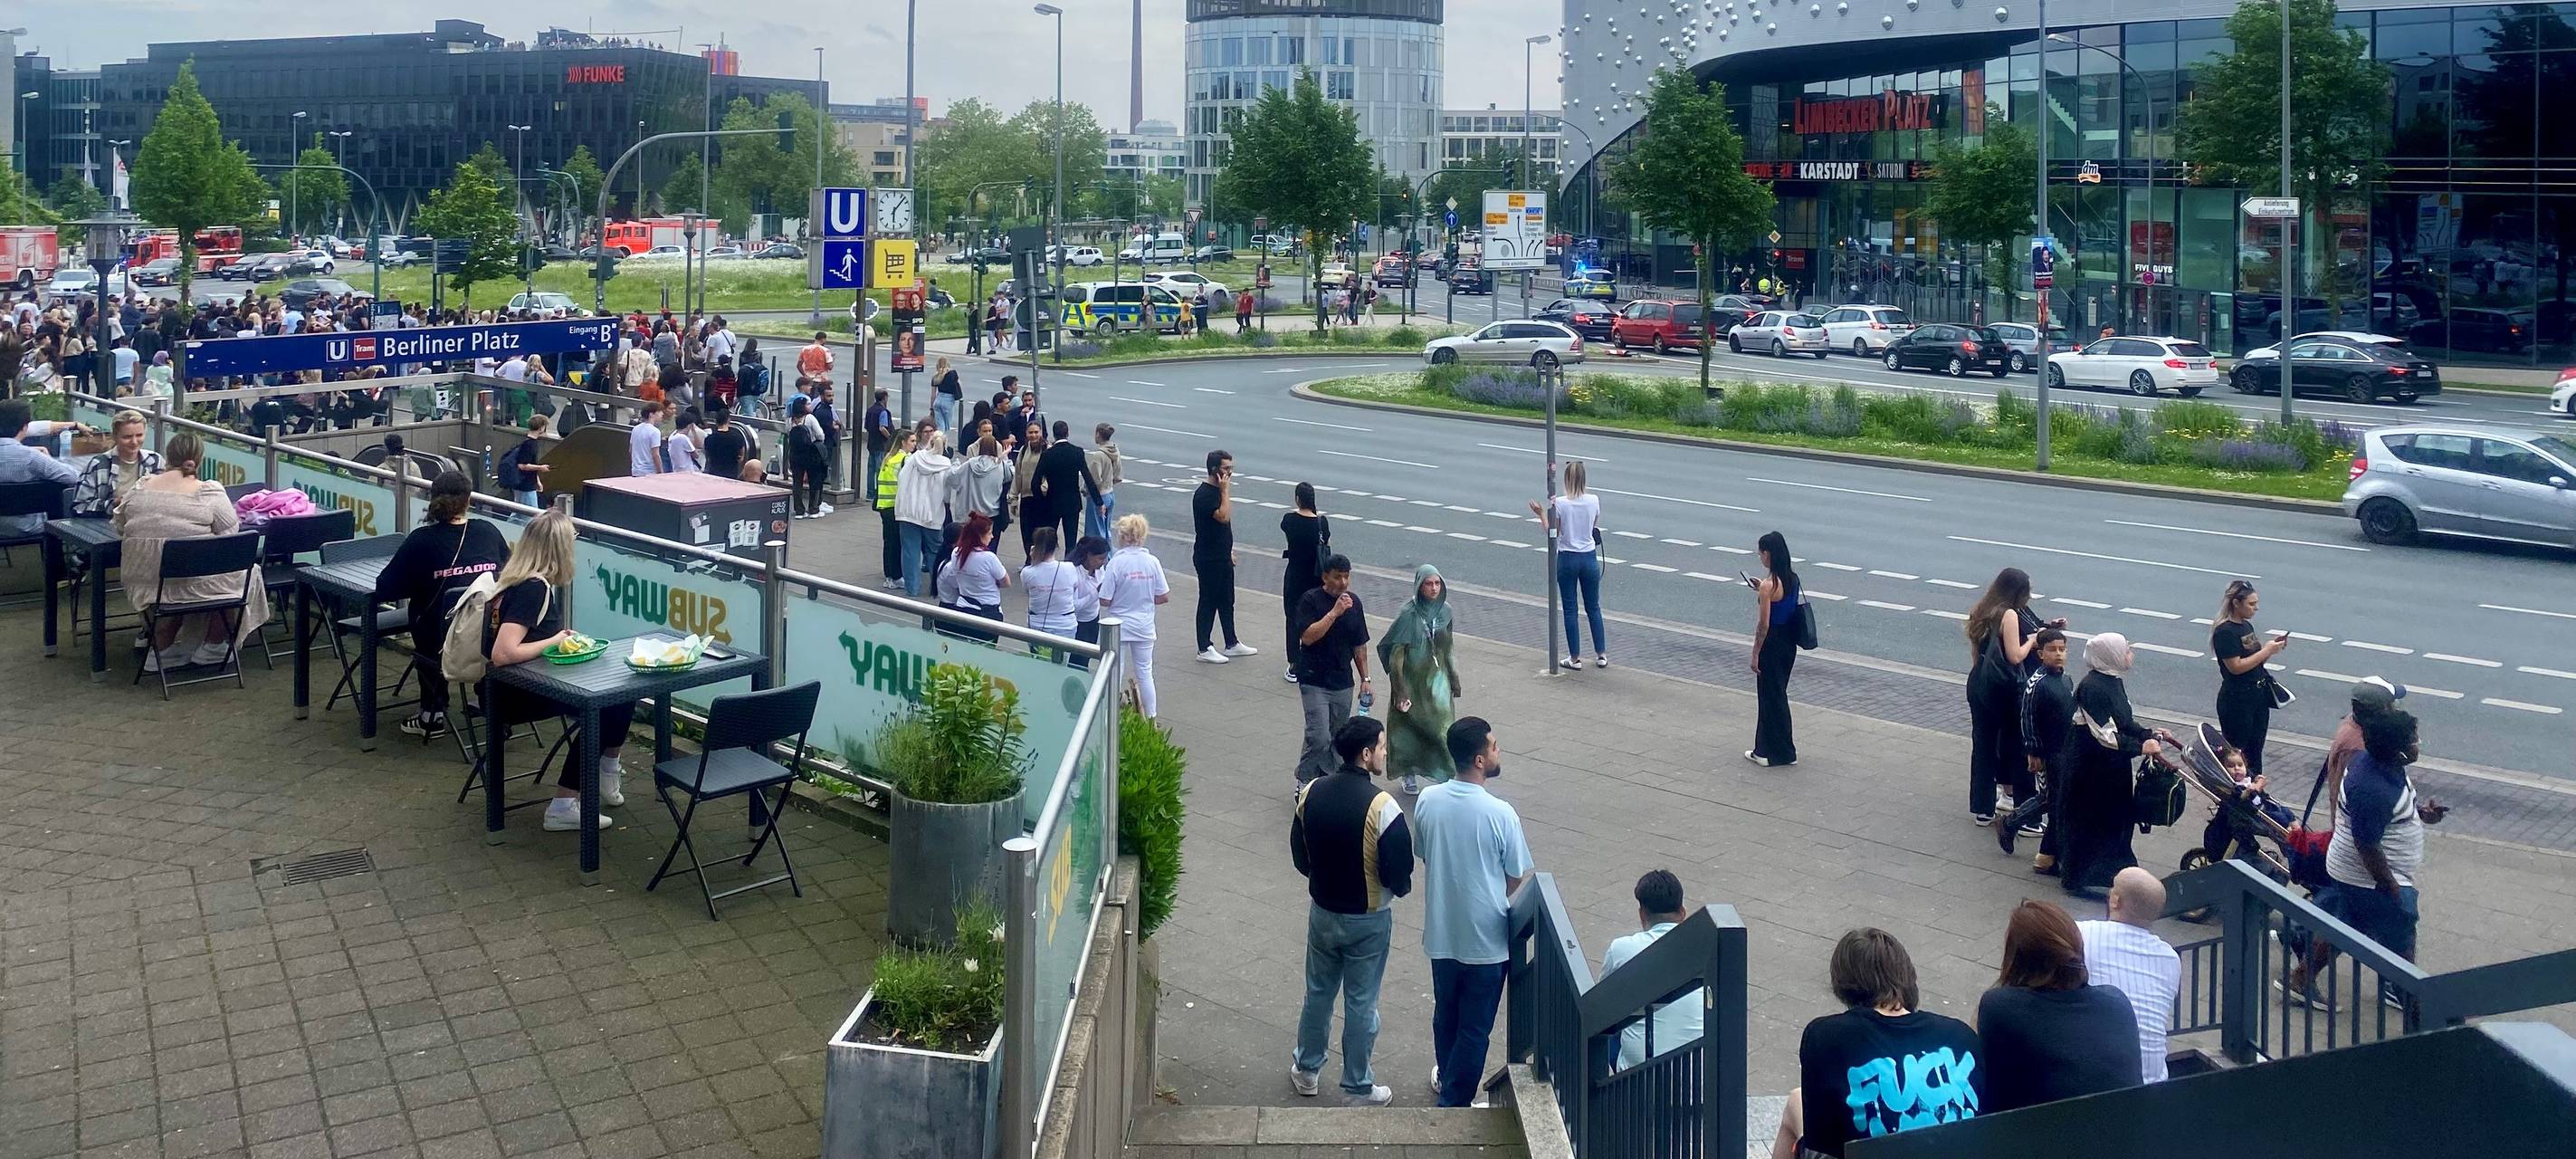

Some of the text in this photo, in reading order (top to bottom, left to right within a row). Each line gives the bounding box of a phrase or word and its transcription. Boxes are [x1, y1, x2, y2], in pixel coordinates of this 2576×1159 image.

[584, 65, 624, 82] FUNKE
[1795, 89, 1932, 134] LIMBECKER PLATZ
[1800, 162, 1859, 180] KARSTADT
[1877, 163, 1903, 179] SATURN
[831, 193, 859, 233] U
[2153, 264, 2173, 273] GUYS
[569, 324, 611, 343] Eingang B
[329, 330, 520, 360] U Tram Berliner Platz
[434, 562, 497, 580] PEGADOR
[1846, 1046, 1979, 1132] FUCK
